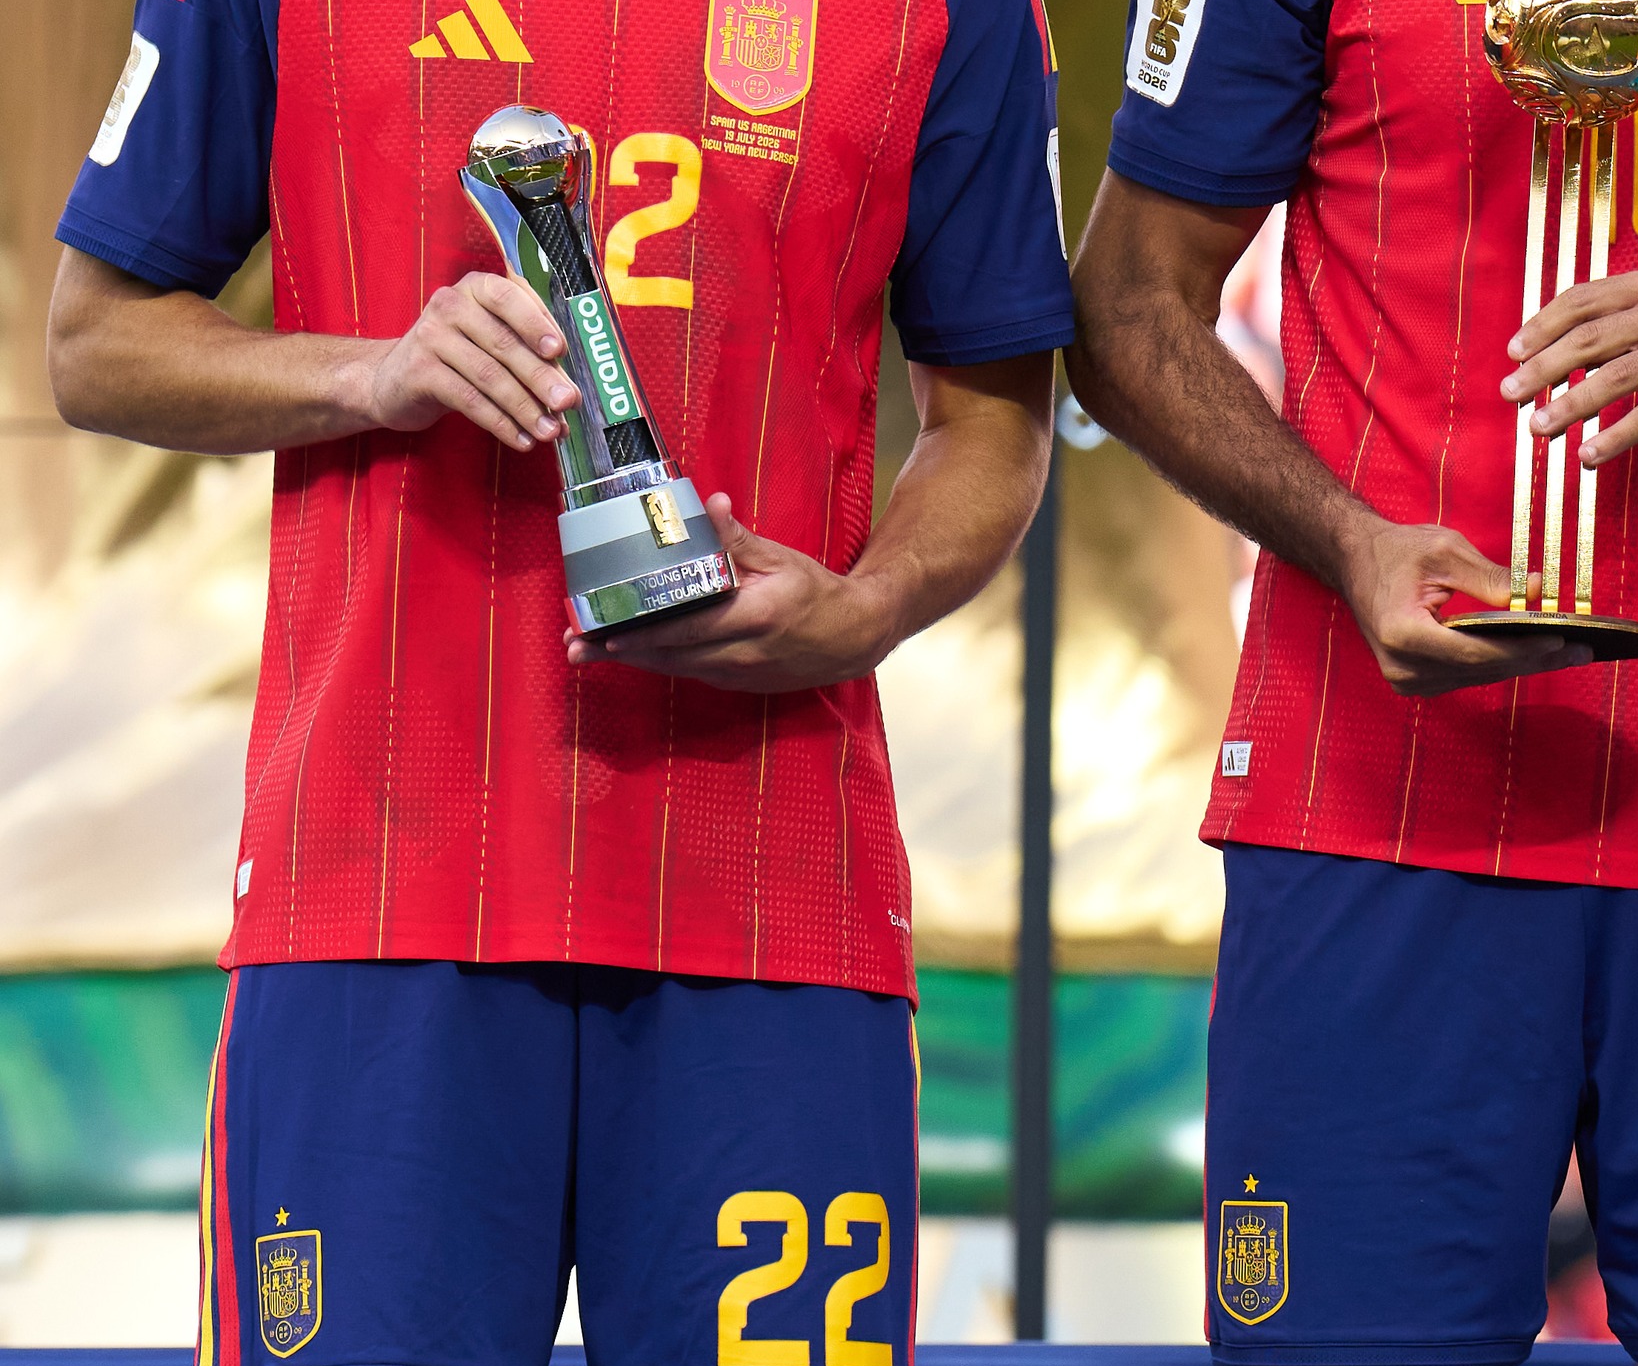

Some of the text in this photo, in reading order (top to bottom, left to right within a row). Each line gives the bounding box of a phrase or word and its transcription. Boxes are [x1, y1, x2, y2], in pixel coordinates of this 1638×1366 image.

[1150, 43, 1167, 58] FIFA
[1138, 69, 1168, 91] 2026
[1159, 66, 1171, 78] CUP
[710, 115, 735, 129] SPAIN
[751, 122, 796, 140] ARGENTINA
[725, 130, 780, 149] 19 JULY 2026
[702, 138, 799, 165] NEW YORK NEW JERSEY
[578, 296, 630, 416] aramco
[640, 556, 725, 591] YOUNG PLAYER OF
[645, 574, 730, 608] THE TOURNAMENT
[1528, 612, 1568, 620] TRIONDA
